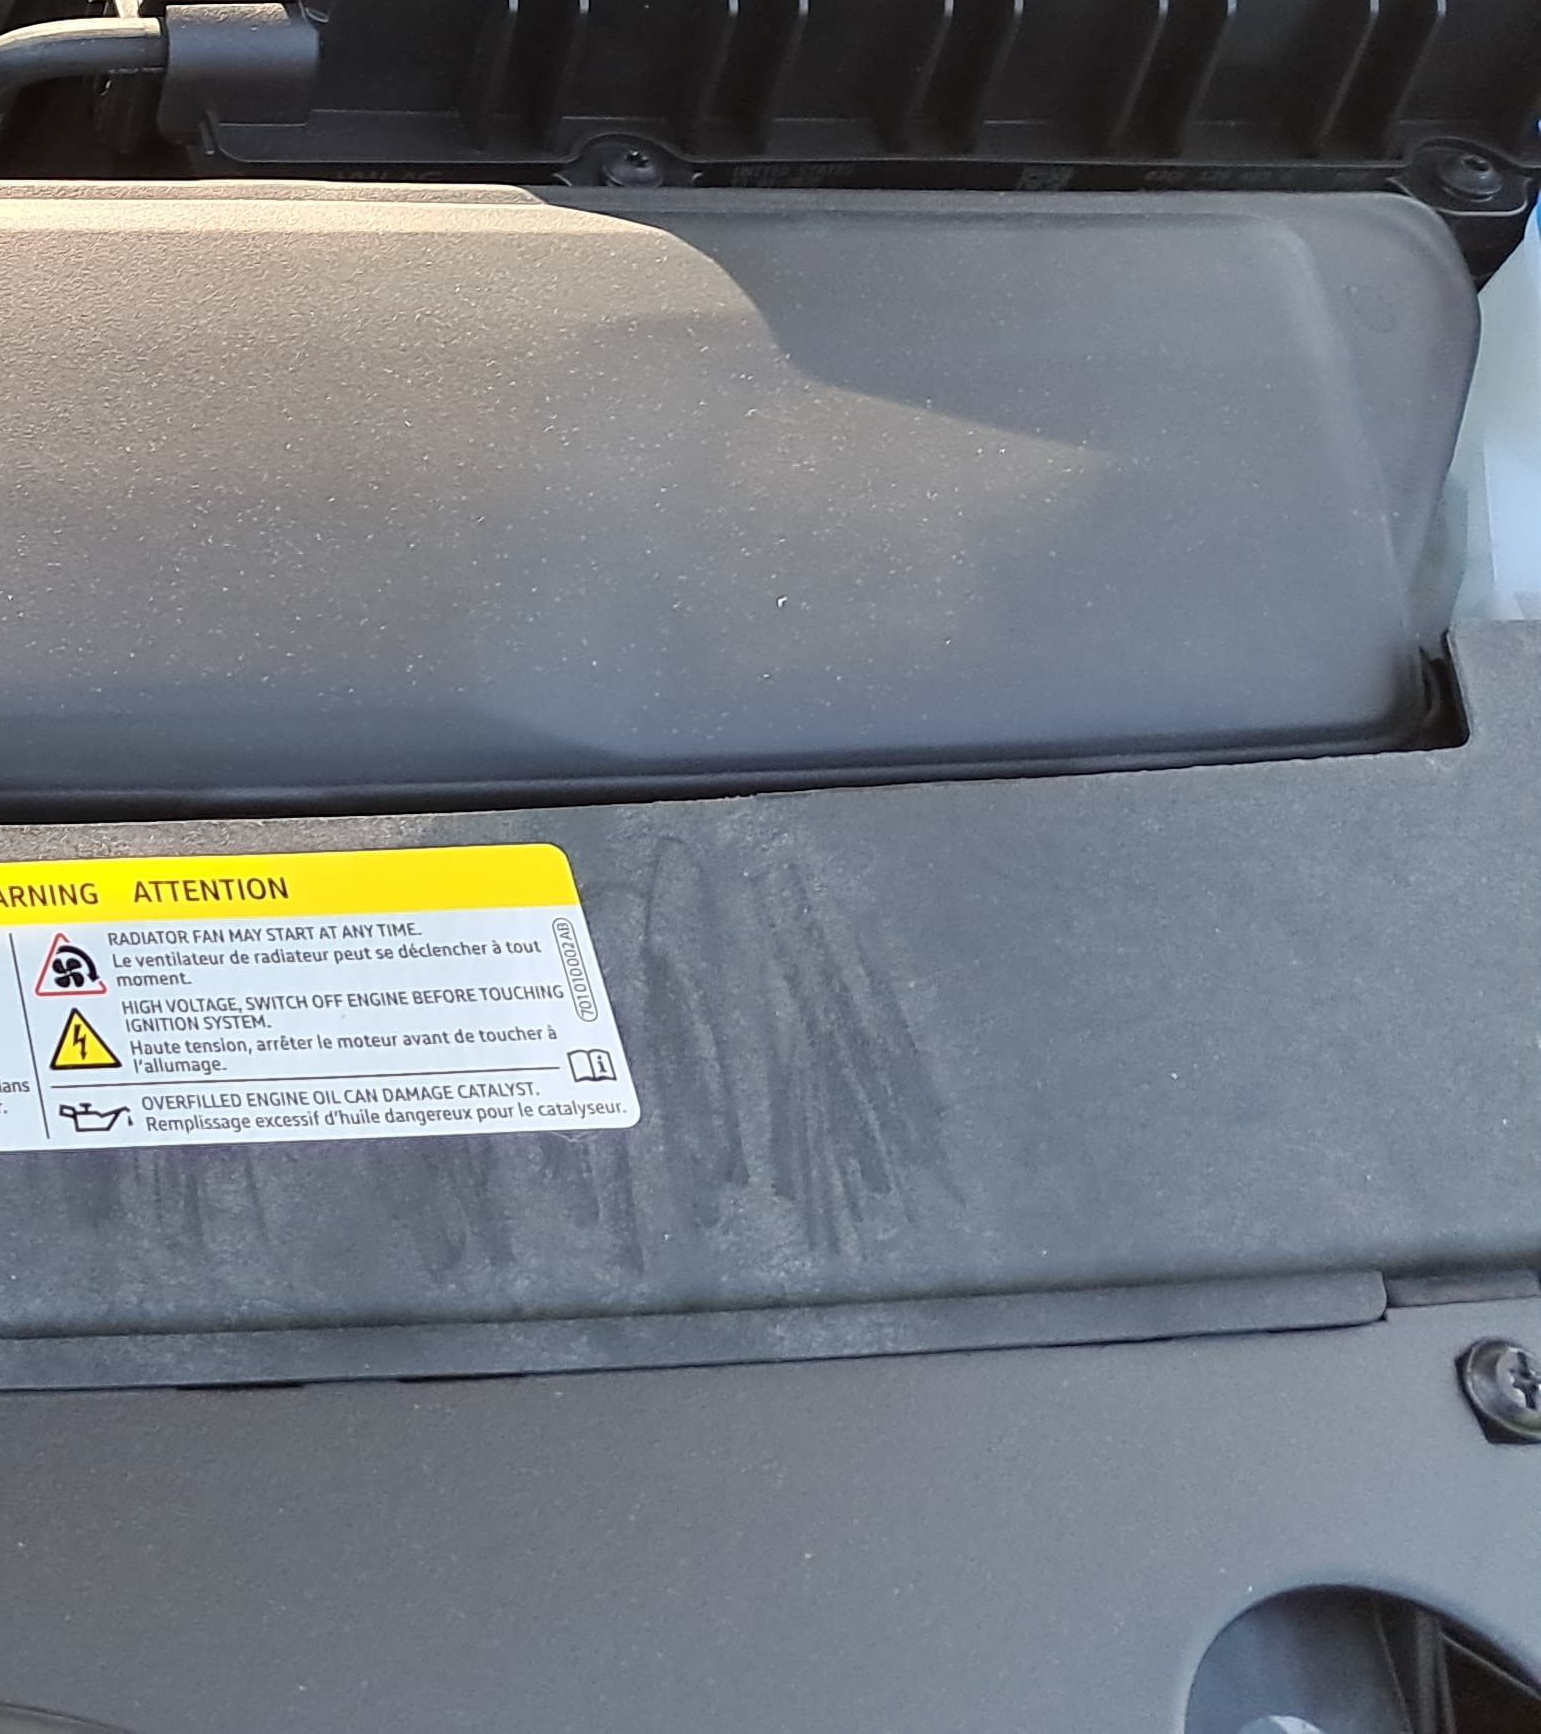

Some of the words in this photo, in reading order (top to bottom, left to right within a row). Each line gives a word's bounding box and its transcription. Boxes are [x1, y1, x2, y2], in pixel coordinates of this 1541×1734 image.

[132, 876, 289, 903] ATTENTION
[106, 928, 190, 947] RADIATOR
[191, 928, 225, 944] FAN
[227, 927, 262, 943] MAY
[264, 925, 315, 942] START
[318, 924, 338, 940] AT
[341, 923, 374, 940] ANY
[374, 921, 422, 938] TIME.
[111, 952, 132, 969] Le
[133, 950, 225, 968] ventilateur
[228, 948, 250, 965] de
[252, 947, 329, 964] radiateur
[332, 946, 373, 965] peut
[373, 947, 394, 960] se
[396, 940, 487, 959] déclencher
[491, 938, 502, 955] à
[504, 939, 542, 954] tout
[115, 971, 192, 987] moment.
[120, 998, 163, 1015] HIGH
[164, 996, 243, 1014] VOLTAGE,
[244, 994, 309, 1011] SWITCH
[310, 992, 343, 1009] OFF
[345, 990, 409, 1008] ENGINE
[410, 987, 478, 1005] BEFORE
[477, 983, 565, 1002] TOUCHING
[124, 1015, 200, 1033] IGNITION
[202, 1013, 272, 1031] SYSTEM.
[128, 1038, 181, 1060] Haute
[183, 1036, 253, 1055] tension,
[255, 1033, 313, 1052] arrêter
[315, 1032, 333, 1050] le
[336, 1033, 398, 1049] moteur
[401, 1030, 451, 1047] avant
[452, 1027, 475, 1044] de
[477, 1024, 543, 1043] toucher
[546, 1023, 558, 1040] à
[140, 1092, 242, 1111] OVERFILLED
[244, 1090, 310, 1108] ENGINE
[311, 1089, 342, 1106] OIL
[342, 1087, 379, 1104] CAN
[380, 1084, 455, 1103] DAMAGE
[456, 1080, 540, 1099] CATALYST.
[144, 1113, 251, 1135] Remplissage
[253, 1109, 320, 1129] excessif
[383, 1106, 473, 1127] dangereux
[474, 1105, 514, 1123] pour
[516, 1100, 534, 1118] le
[536, 1098, 627, 1120] catalyseur.
